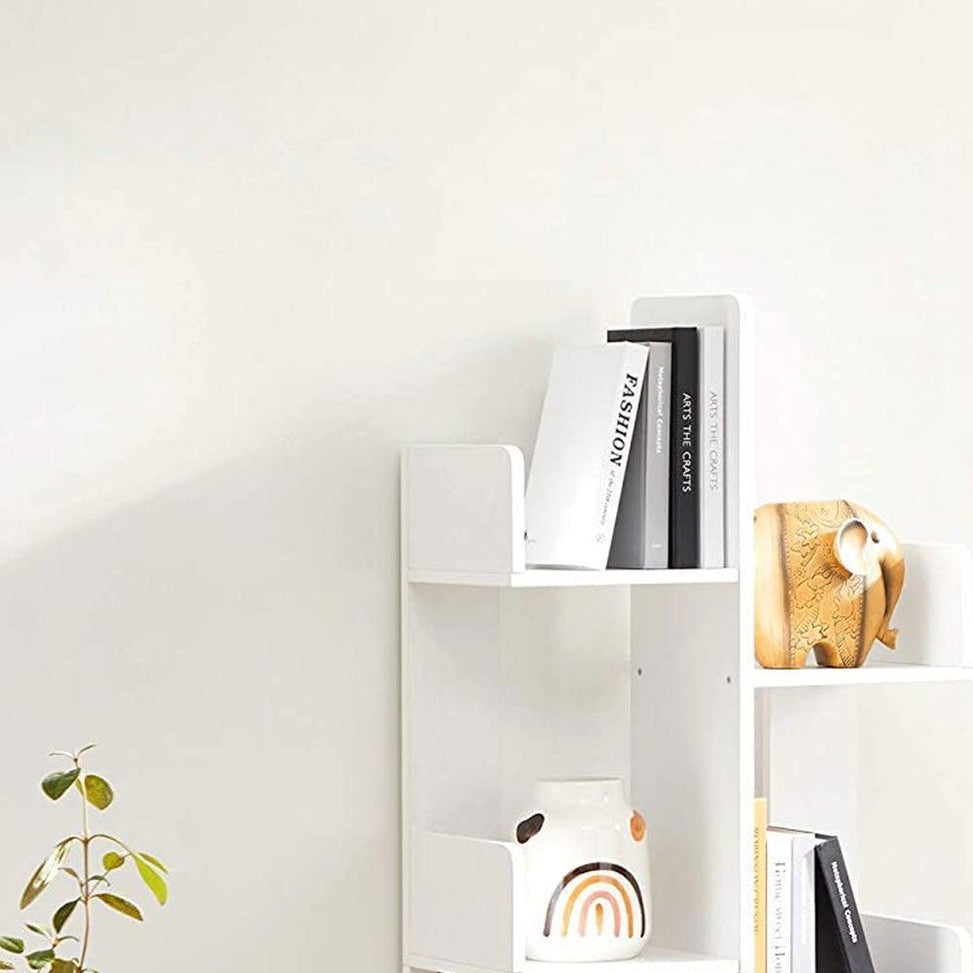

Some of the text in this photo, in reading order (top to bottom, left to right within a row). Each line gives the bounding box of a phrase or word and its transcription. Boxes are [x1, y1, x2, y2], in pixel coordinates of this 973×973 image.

[610, 373, 638, 467] FASHION
[682, 392, 692, 492] ARTS THE CRAFTS
[709, 391, 719, 491] ARTS THE CRAFTS
